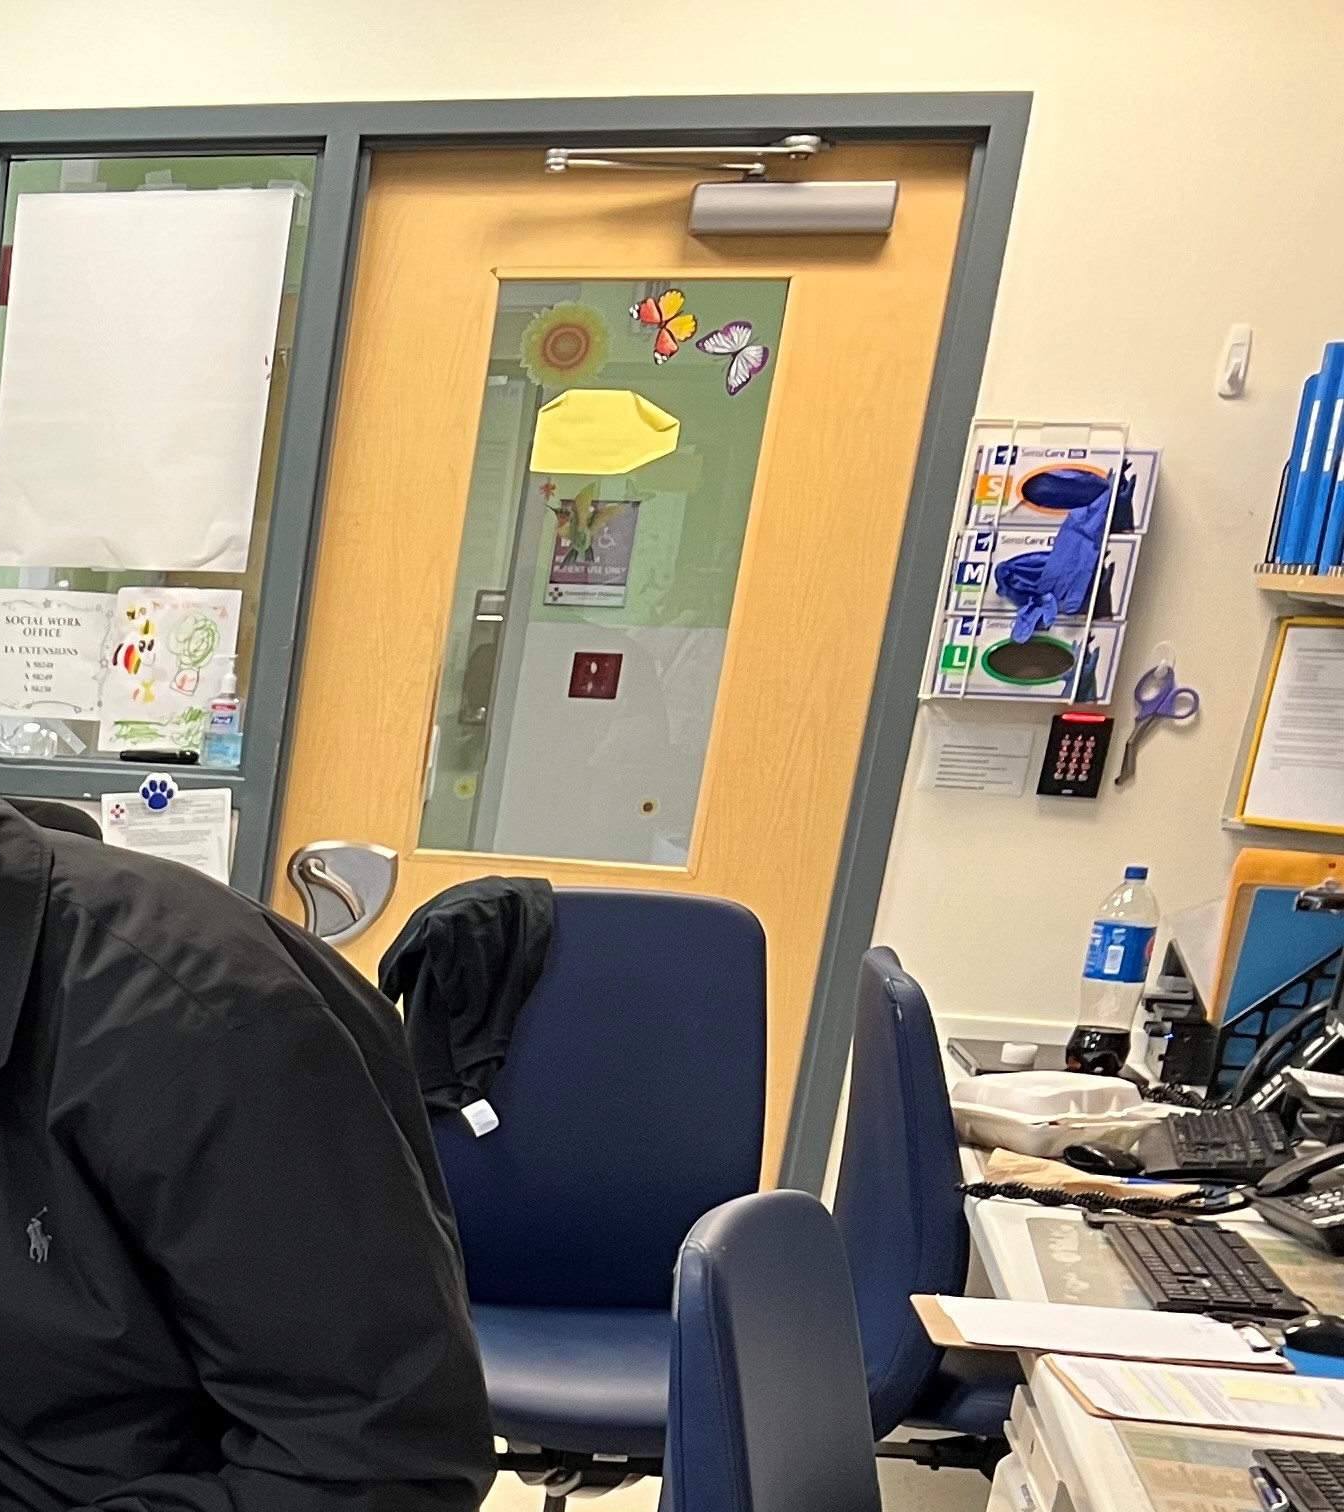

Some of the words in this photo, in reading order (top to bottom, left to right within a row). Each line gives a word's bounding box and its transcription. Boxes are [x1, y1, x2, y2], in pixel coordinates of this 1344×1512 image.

[987, 477, 1001, 497] S
[963, 563, 985, 584] M
[5, 616, 43, 626] SOCIAL
[47, 617, 81, 627] WORK
[23, 627, 61, 638] OFFICE
[18, 646, 79, 656] EXTENSIONS
[952, 647, 968, 667] L
